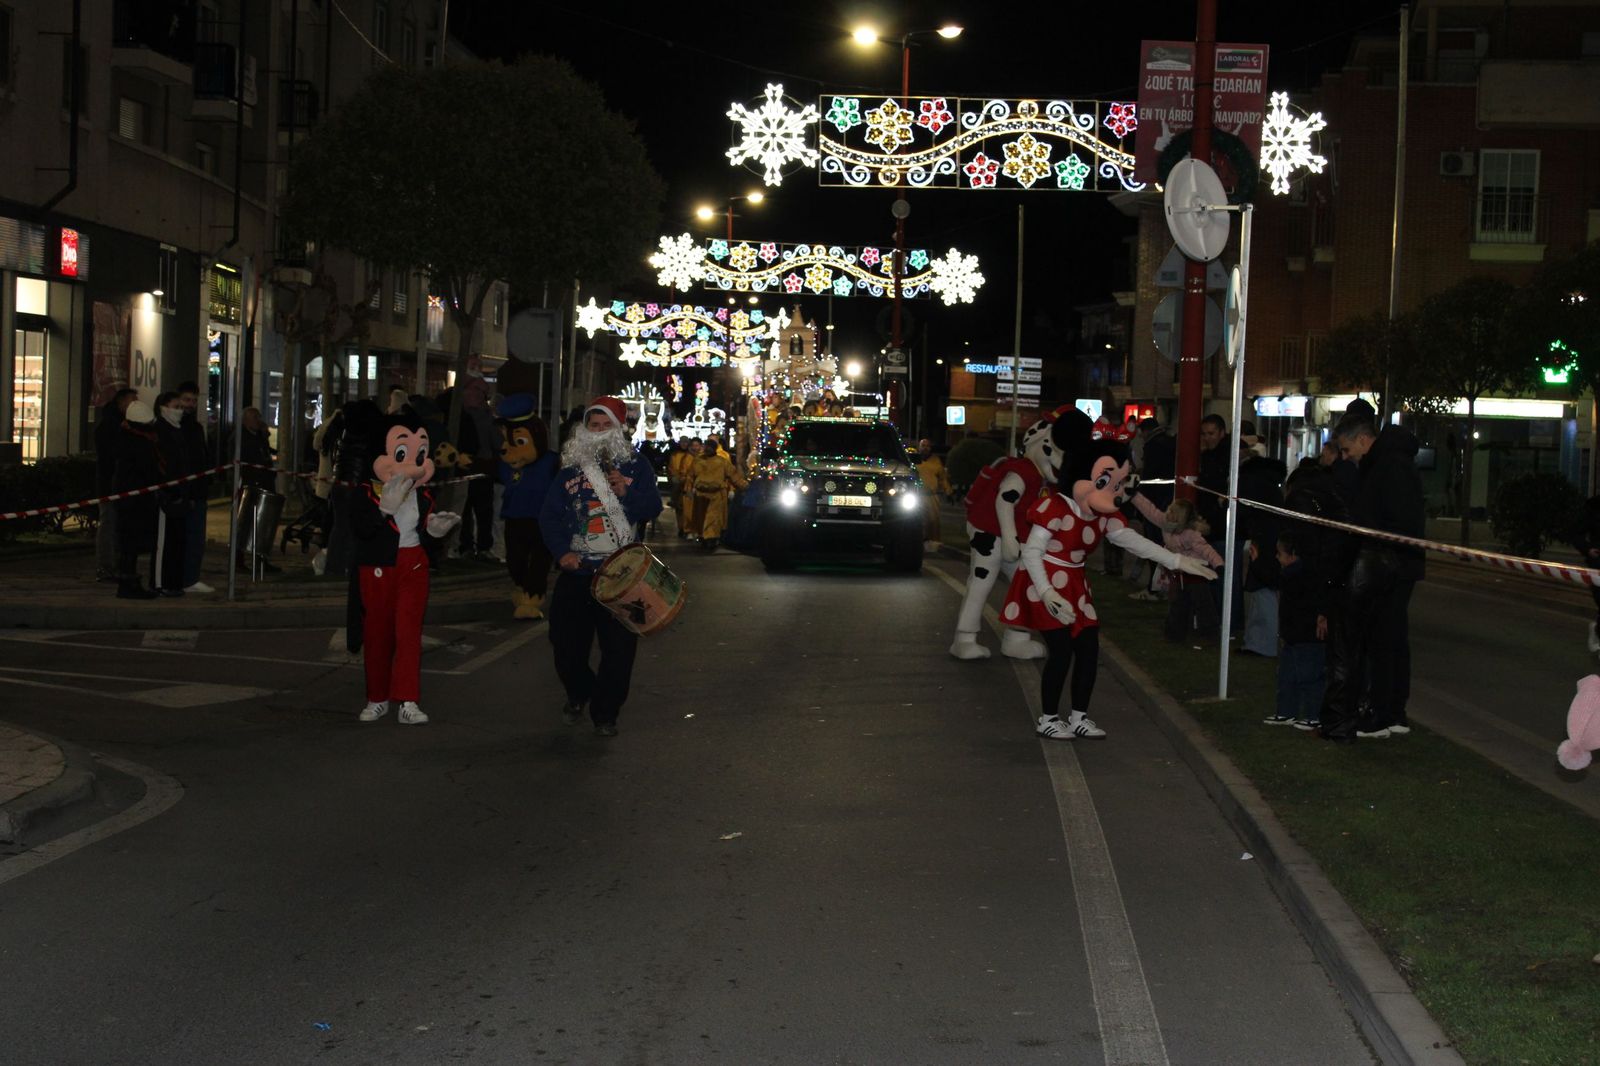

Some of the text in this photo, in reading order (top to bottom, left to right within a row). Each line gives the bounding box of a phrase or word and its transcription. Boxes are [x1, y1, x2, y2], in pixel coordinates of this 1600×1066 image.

[1145, 73, 1262, 93] ¿QUÉ TAL EDARÍAN
[1140, 107, 1262, 125] EN TU ÁRBO NAVIDAD?
